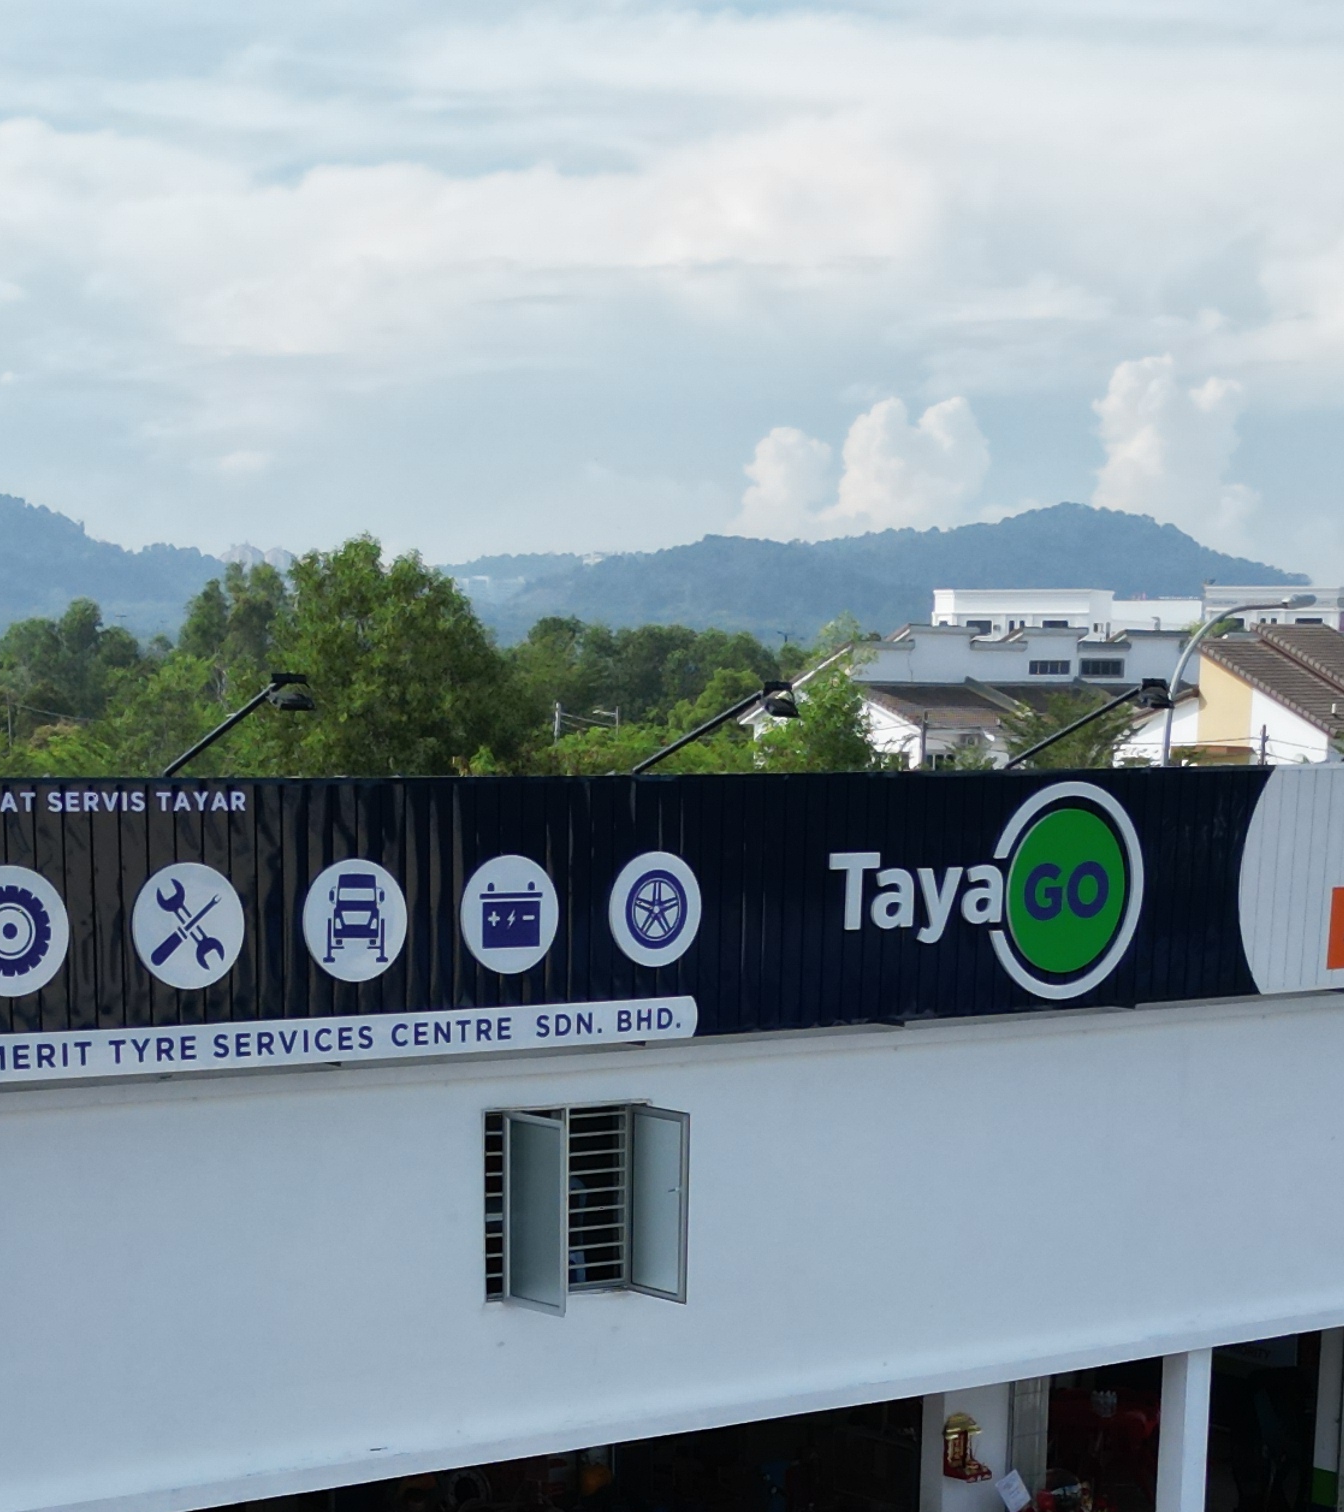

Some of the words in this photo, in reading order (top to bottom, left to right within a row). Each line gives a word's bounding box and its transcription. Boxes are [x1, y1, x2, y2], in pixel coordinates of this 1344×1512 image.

[47, 791, 146, 812] SERVIS
[156, 791, 247, 812] TAYAR
[829, 852, 1004, 944] Taya
[1024, 860, 1109, 921] GO
[108, 1035, 197, 1064] TYRE
[213, 1025, 374, 1058] SERVICES
[391, 1017, 512, 1047] CENTRE
[536, 1012, 604, 1038] SDN.
[616, 1007, 682, 1033] BHD.
